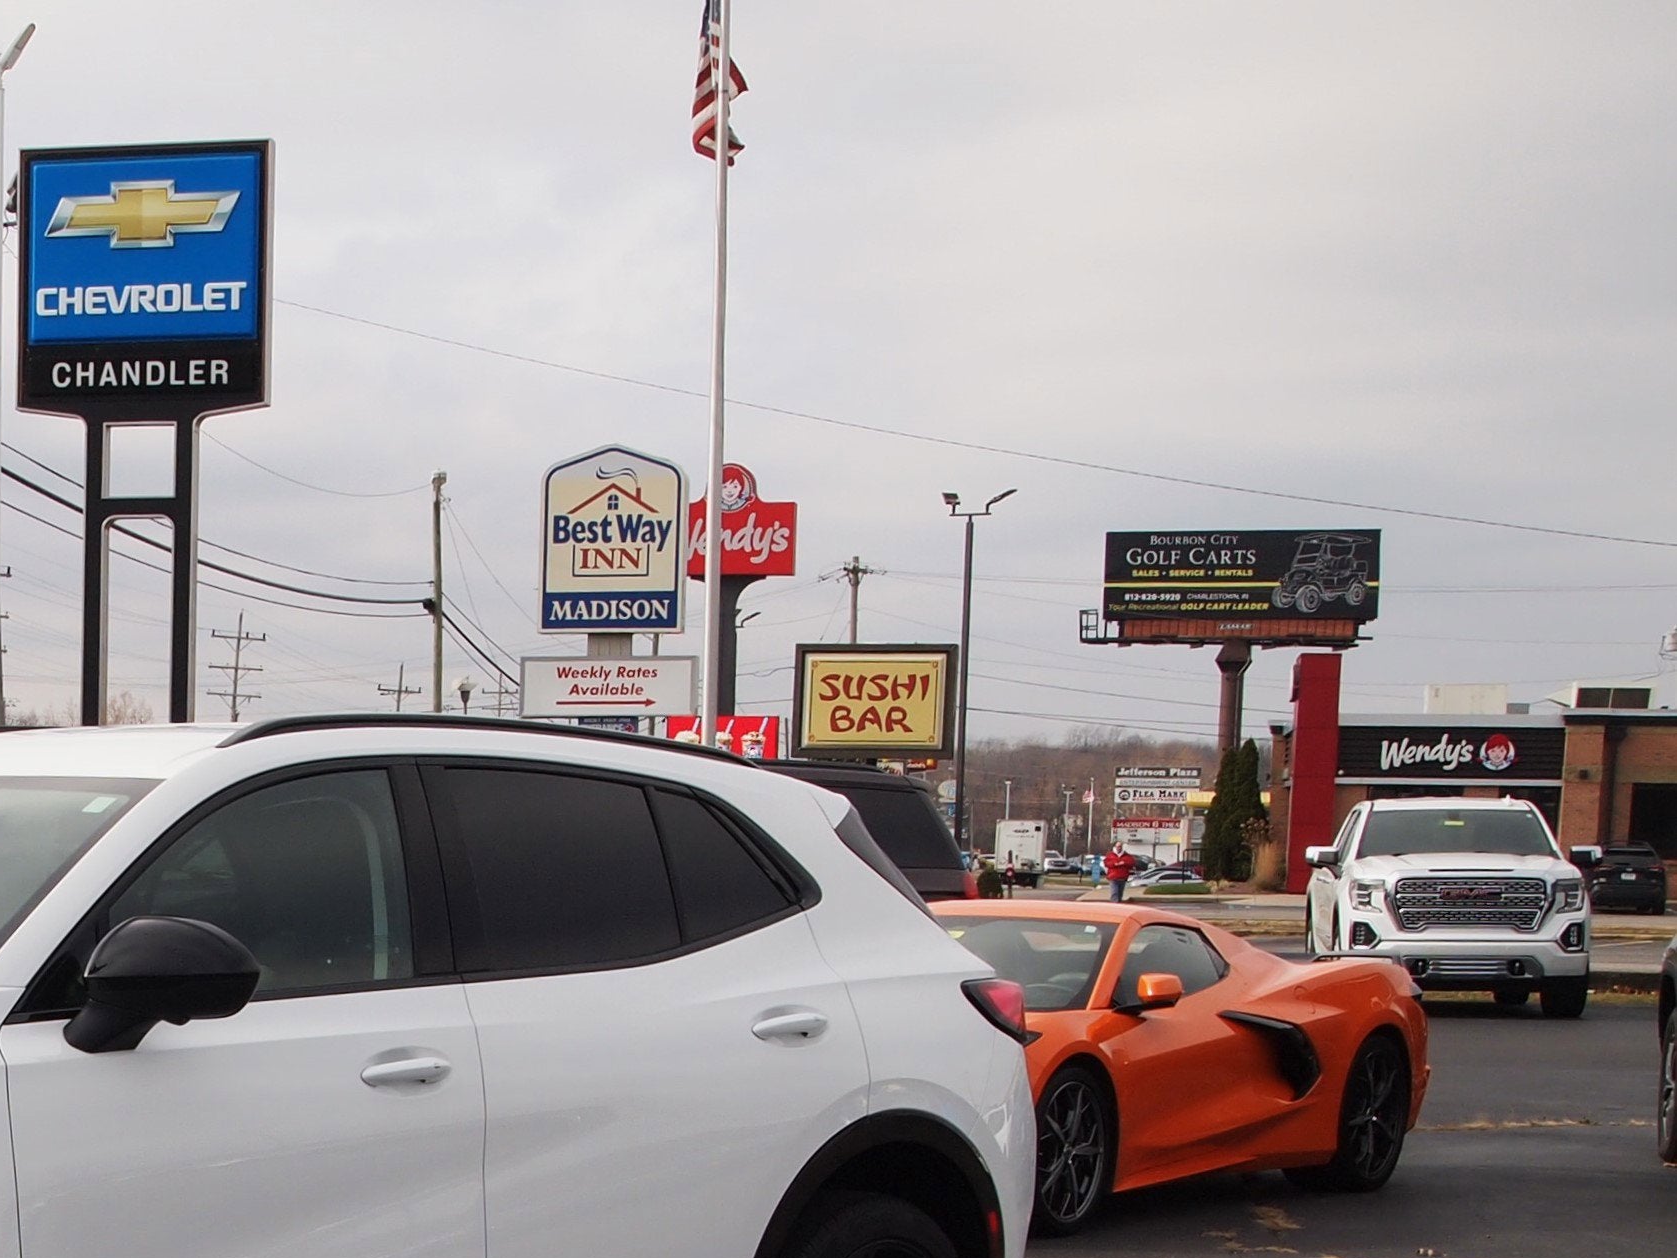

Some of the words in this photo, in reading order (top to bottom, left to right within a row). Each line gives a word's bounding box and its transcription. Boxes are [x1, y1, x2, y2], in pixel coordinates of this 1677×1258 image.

[36, 282, 247, 317] CHEVROLET
[52, 359, 229, 388] CHANDLER
[553, 514, 612, 544] Best
[616, 514, 672, 552] Way
[579, 547, 643, 570] INN
[1126, 548, 1181, 565] GOLF
[1189, 547, 1257, 565] CARTS
[1132, 569, 1160, 577] SALES
[1168, 569, 1205, 577] SERVICE
[1214, 568, 1253, 577] RENTALS
[549, 599, 670, 621] MADISON
[1180, 602, 1204, 611] GOLF
[1205, 602, 1231, 611] CART
[1232, 602, 1269, 611] LEADER
[556, 665, 611, 681] Weekly
[616, 665, 658, 678] Rates
[568, 683, 644, 696] Available
[818, 673, 930, 702] SUSHI
[830, 705, 914, 733] BAR
[1381, 734, 1474, 771] Wendy's
[1117, 767, 1166, 776] Jefferson
[1169, 767, 1198, 776] Plaza
[1132, 789, 1154, 798] FLEA
